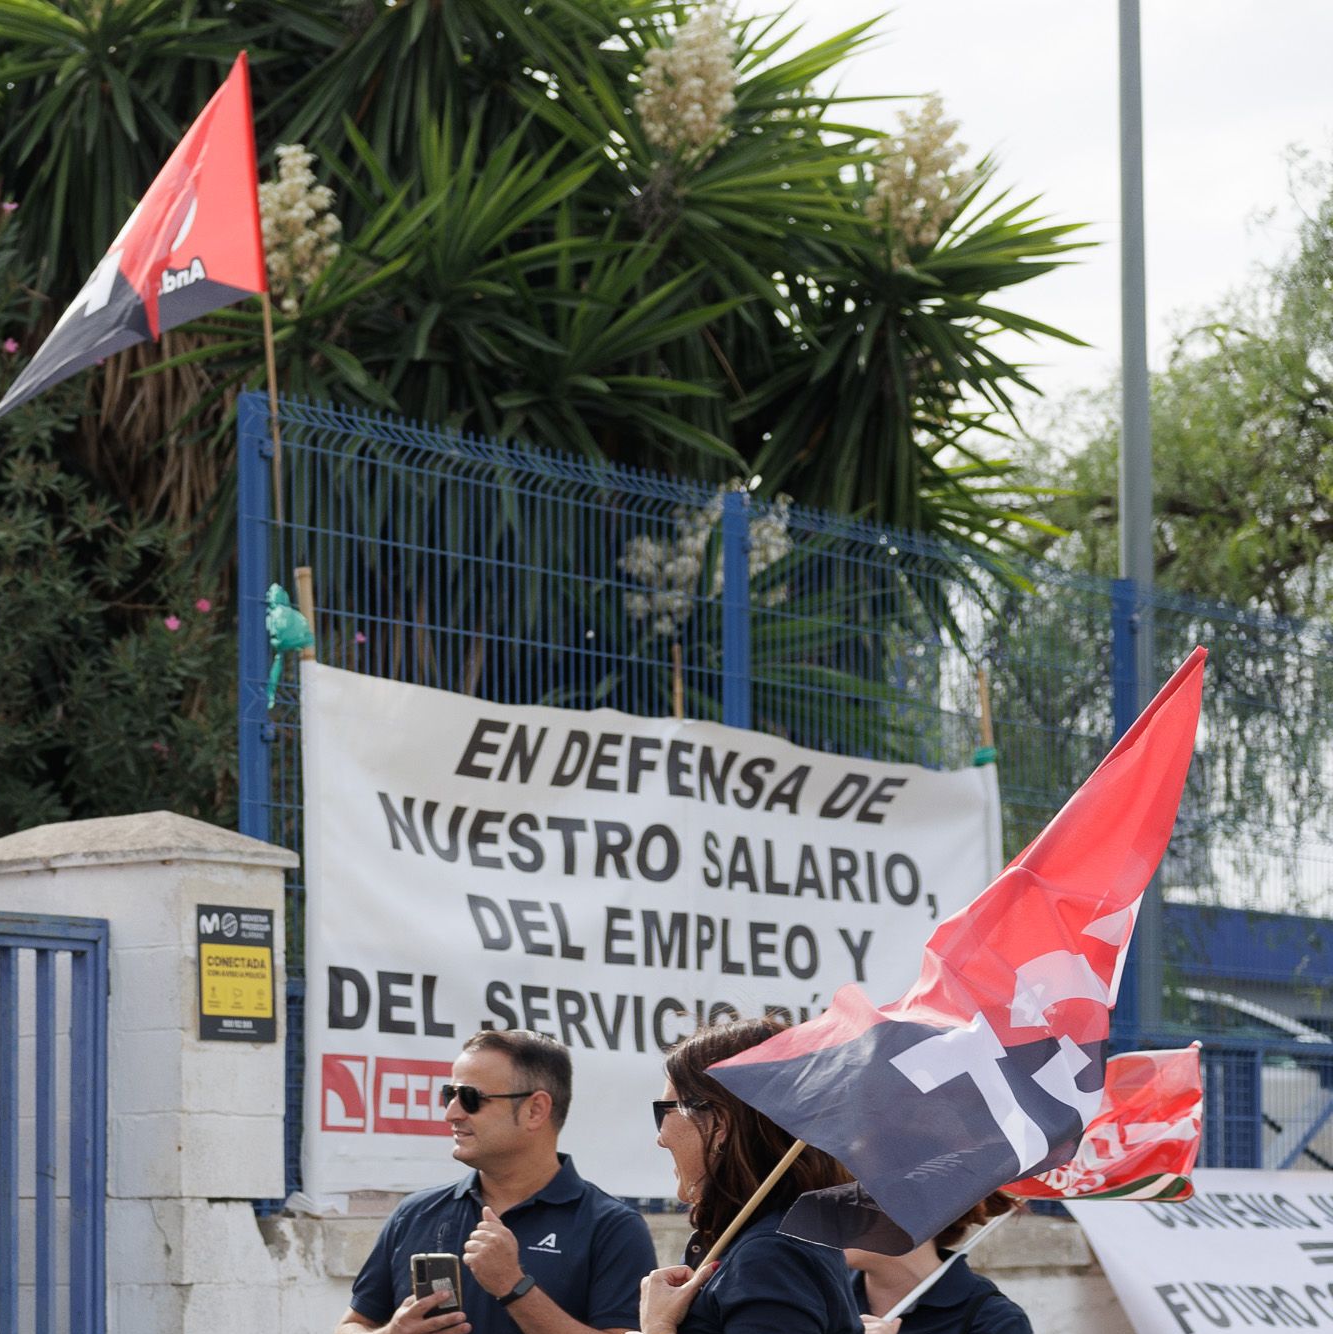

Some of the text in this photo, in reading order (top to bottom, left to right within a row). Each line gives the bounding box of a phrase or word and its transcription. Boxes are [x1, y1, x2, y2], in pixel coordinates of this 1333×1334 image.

[455, 718, 908, 825] EN DEFENSA DE
[377, 791, 938, 920] NUESTRO SALARIO,
[206, 955, 267, 969] CONECTADA
[466, 893, 874, 983] DEL EMPLEO Y
[328, 965, 455, 1038] DEL
